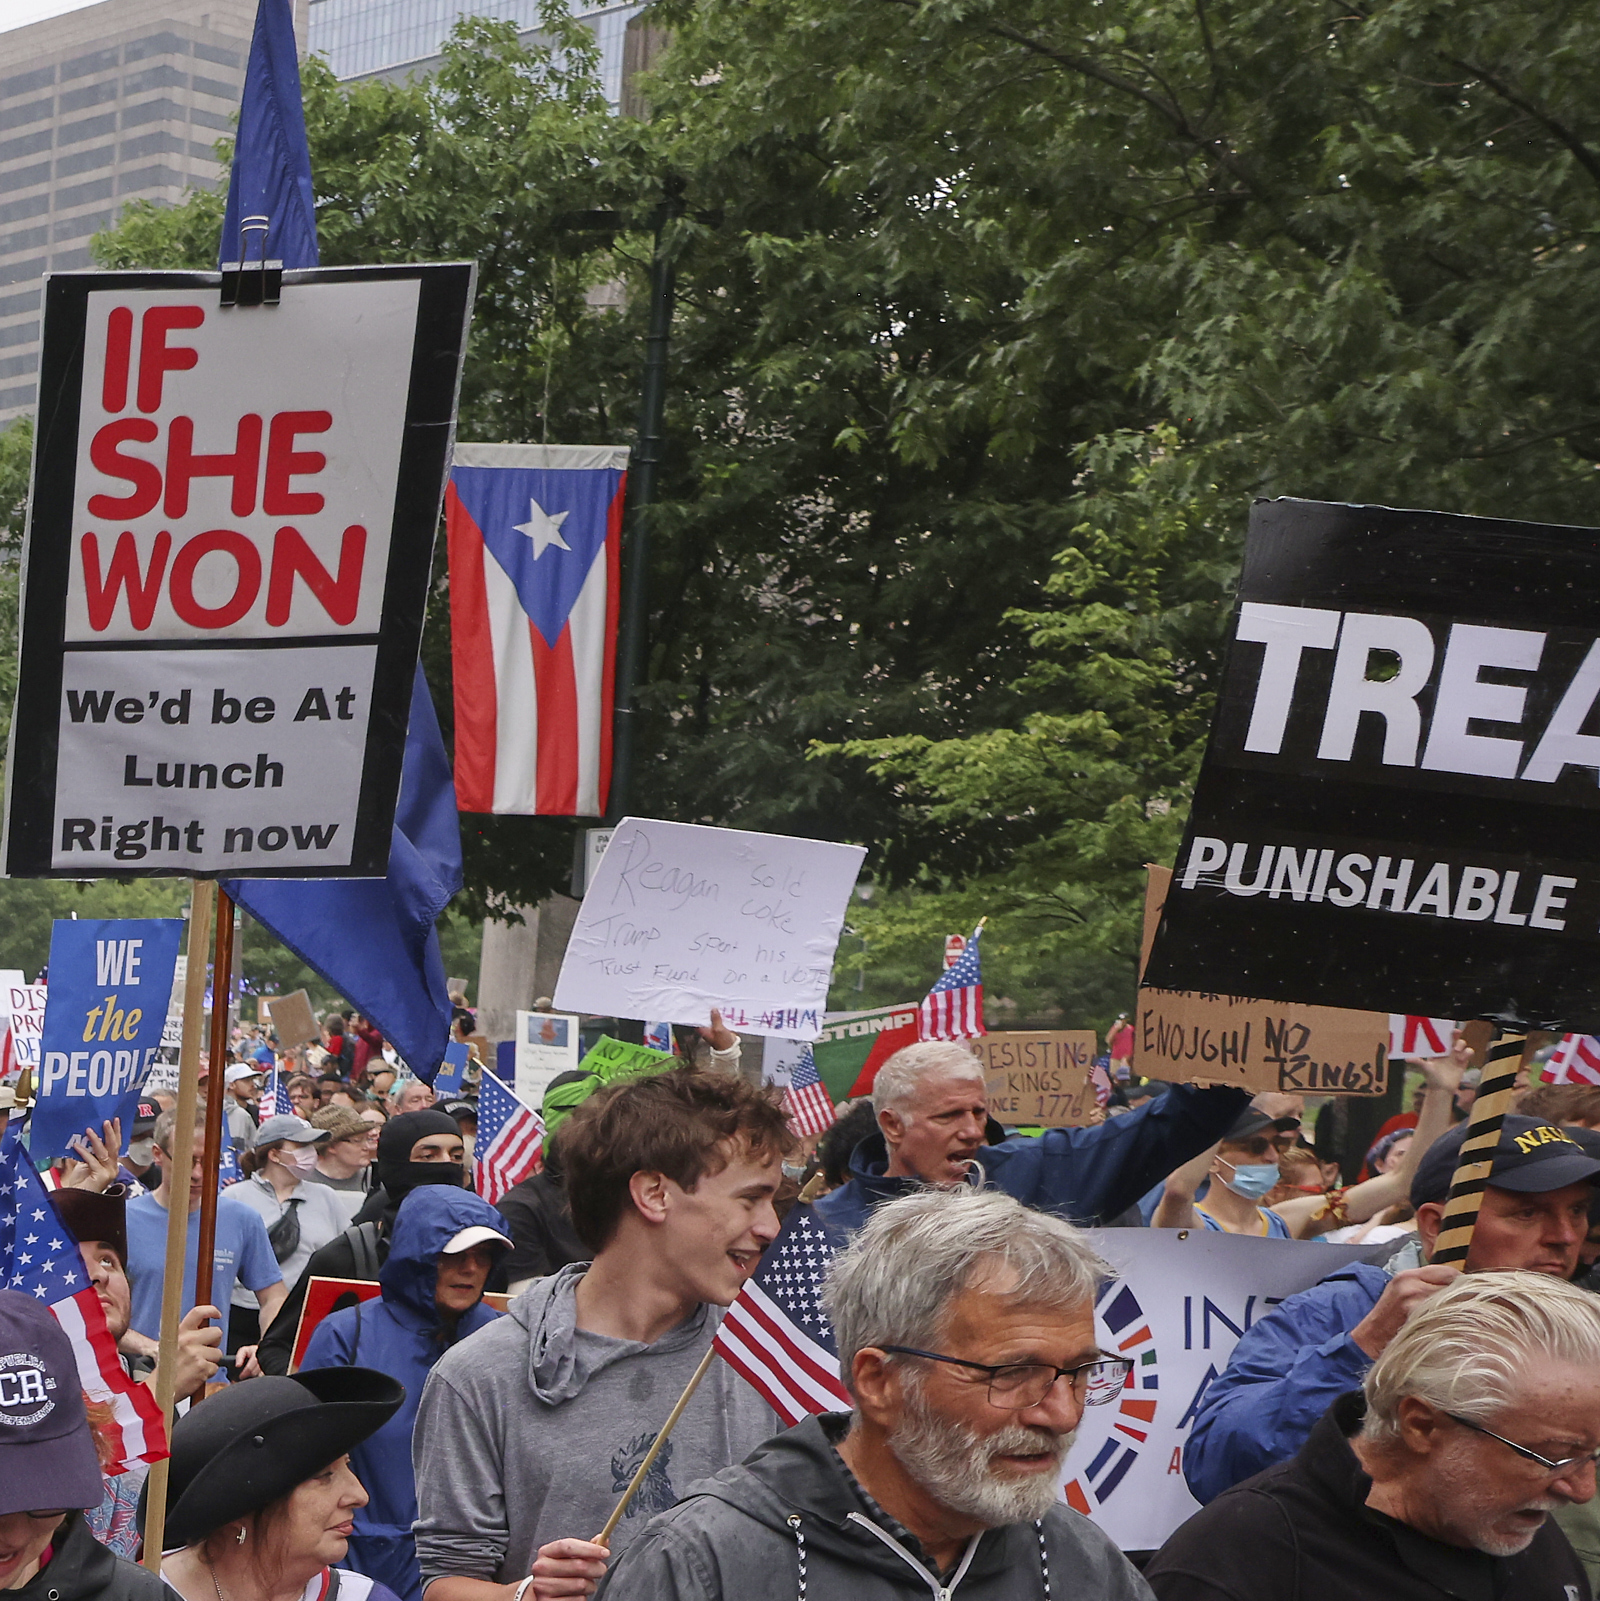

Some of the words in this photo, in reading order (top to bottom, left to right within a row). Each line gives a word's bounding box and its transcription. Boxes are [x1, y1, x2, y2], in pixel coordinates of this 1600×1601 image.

[102, 306, 205, 413] IF
[87, 411, 333, 521] SHE
[81, 524, 368, 631] WON
[66, 690, 191, 725] We'd
[211, 689, 276, 725] be
[294, 687, 355, 722] At
[123, 754, 284, 790] Lunch
[61, 816, 204, 858] Right
[223, 823, 339, 853] now
[611, 830, 719, 910] Reagan
[1178, 836, 1577, 932] PUNISHABLE
[96, 939, 144, 986] WE
[81, 994, 143, 1043] the
[1143, 1009, 1250, 1074] ENOUGH!
[1265, 1017, 1311, 1056] NO
[42, 1048, 158, 1098] PEOPLE
[1007, 1070, 1062, 1093] KINGS
[1278, 1042, 1386, 1093] KINGS!
[984, 1097, 1018, 1113] INCE
[1034, 1094, 1083, 1119] 1776
